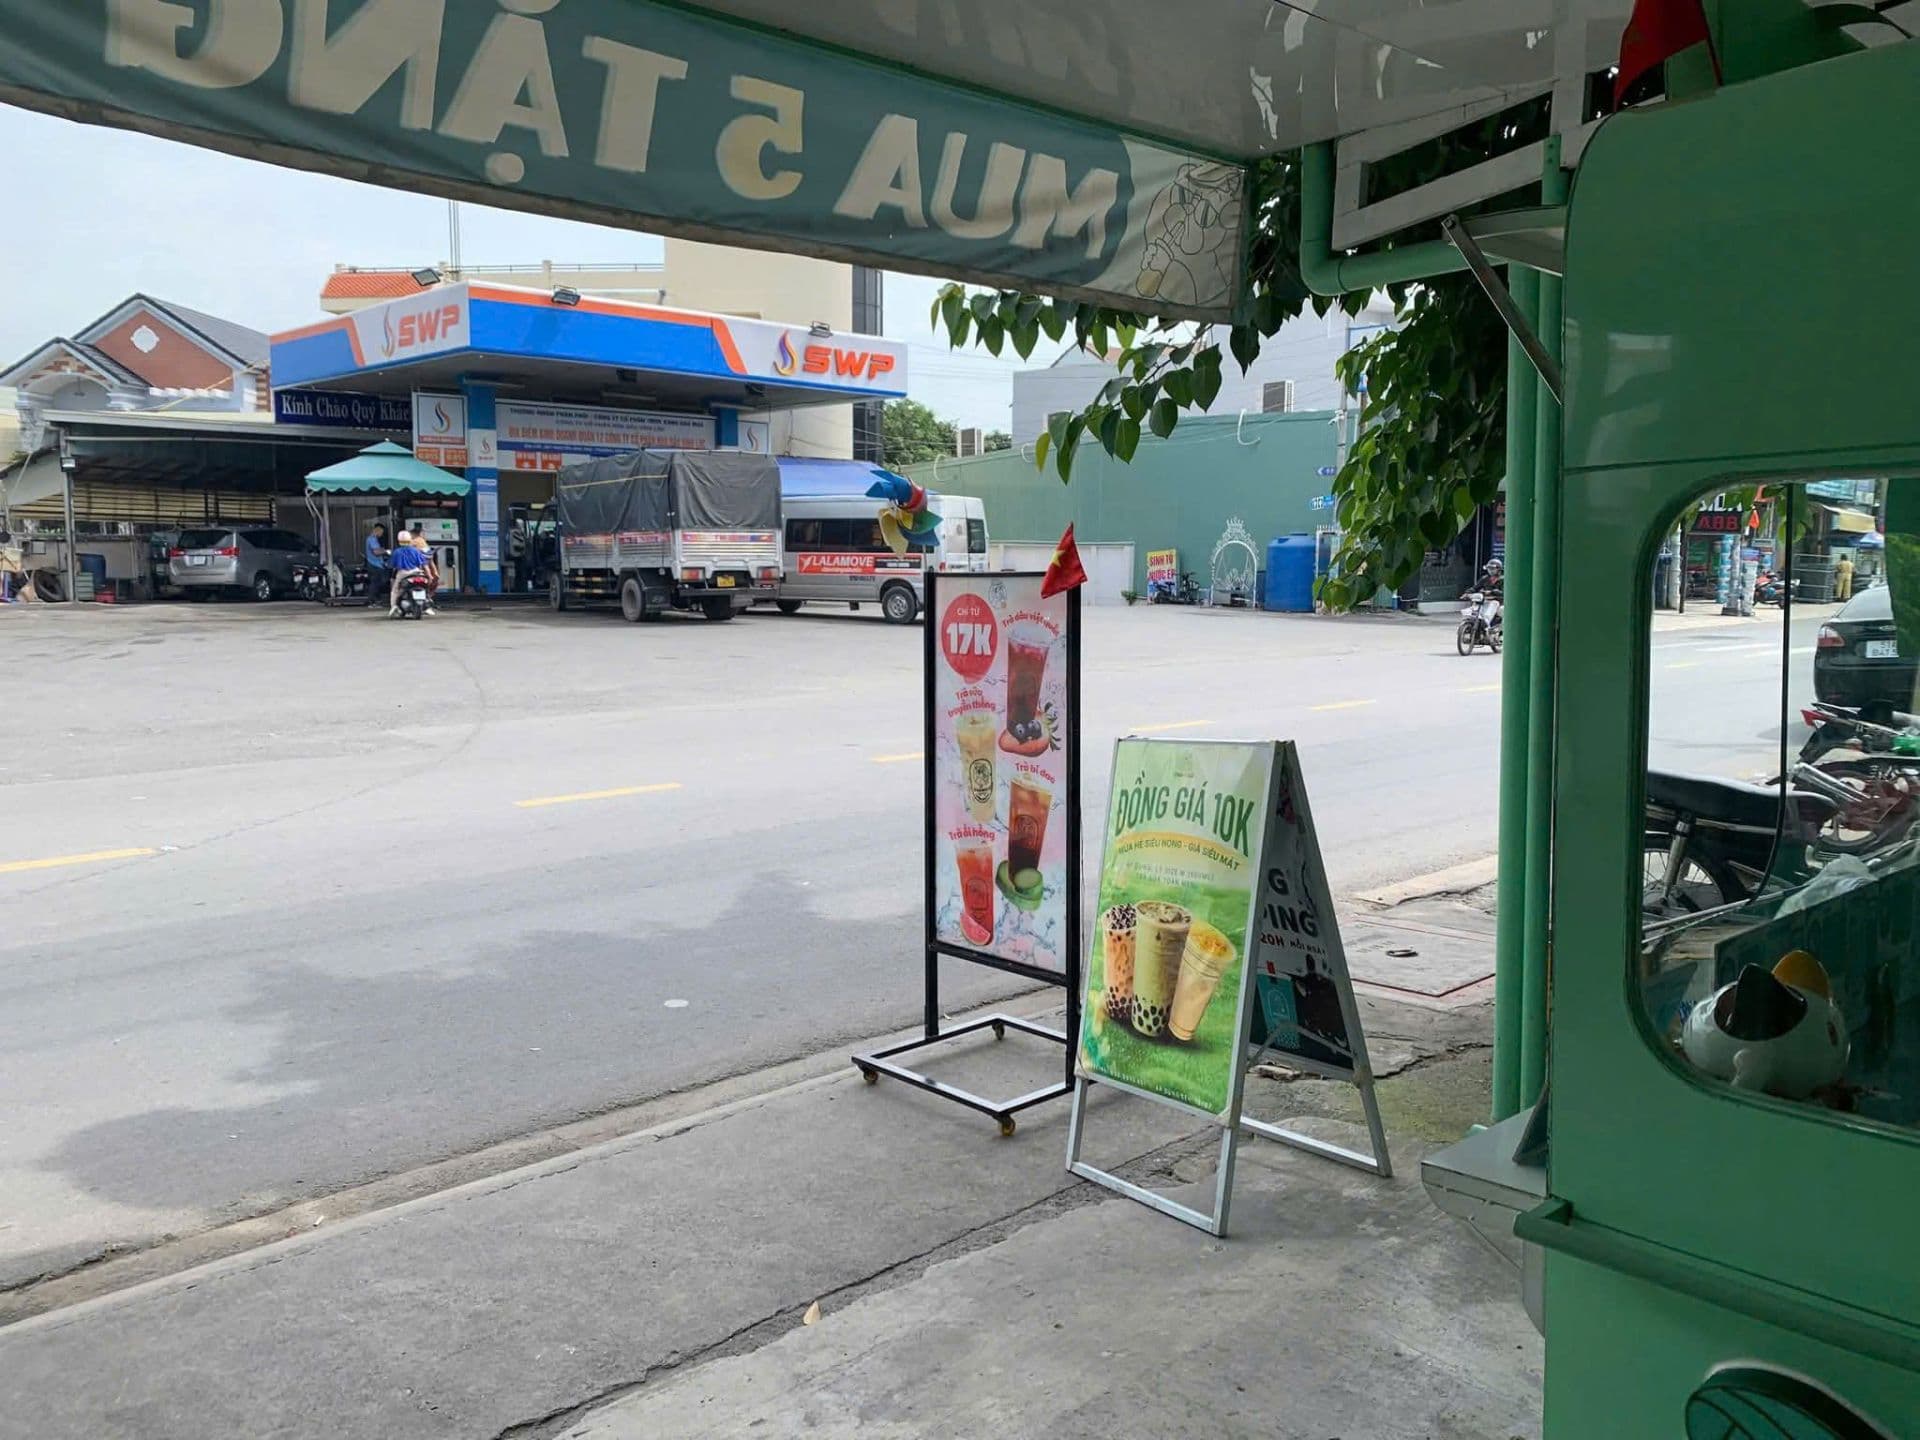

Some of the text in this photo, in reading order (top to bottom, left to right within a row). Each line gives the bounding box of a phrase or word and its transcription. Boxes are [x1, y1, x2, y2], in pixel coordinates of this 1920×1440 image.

[398, 303, 460, 348] SWP
[802, 344, 896, 380] SWP
[281, 394, 313, 416] Kính
[316, 397, 349, 418] Chào
[351, 400, 375, 424] Quý
[812, 555, 874, 568] LALAMOVE
[946, 623, 993, 656] 17K
[1014, 760, 1029, 773] Trà
[1115, 770, 1255, 857] ĐỒNG GIÁ 10K
[948, 828, 963, 841] Trà
